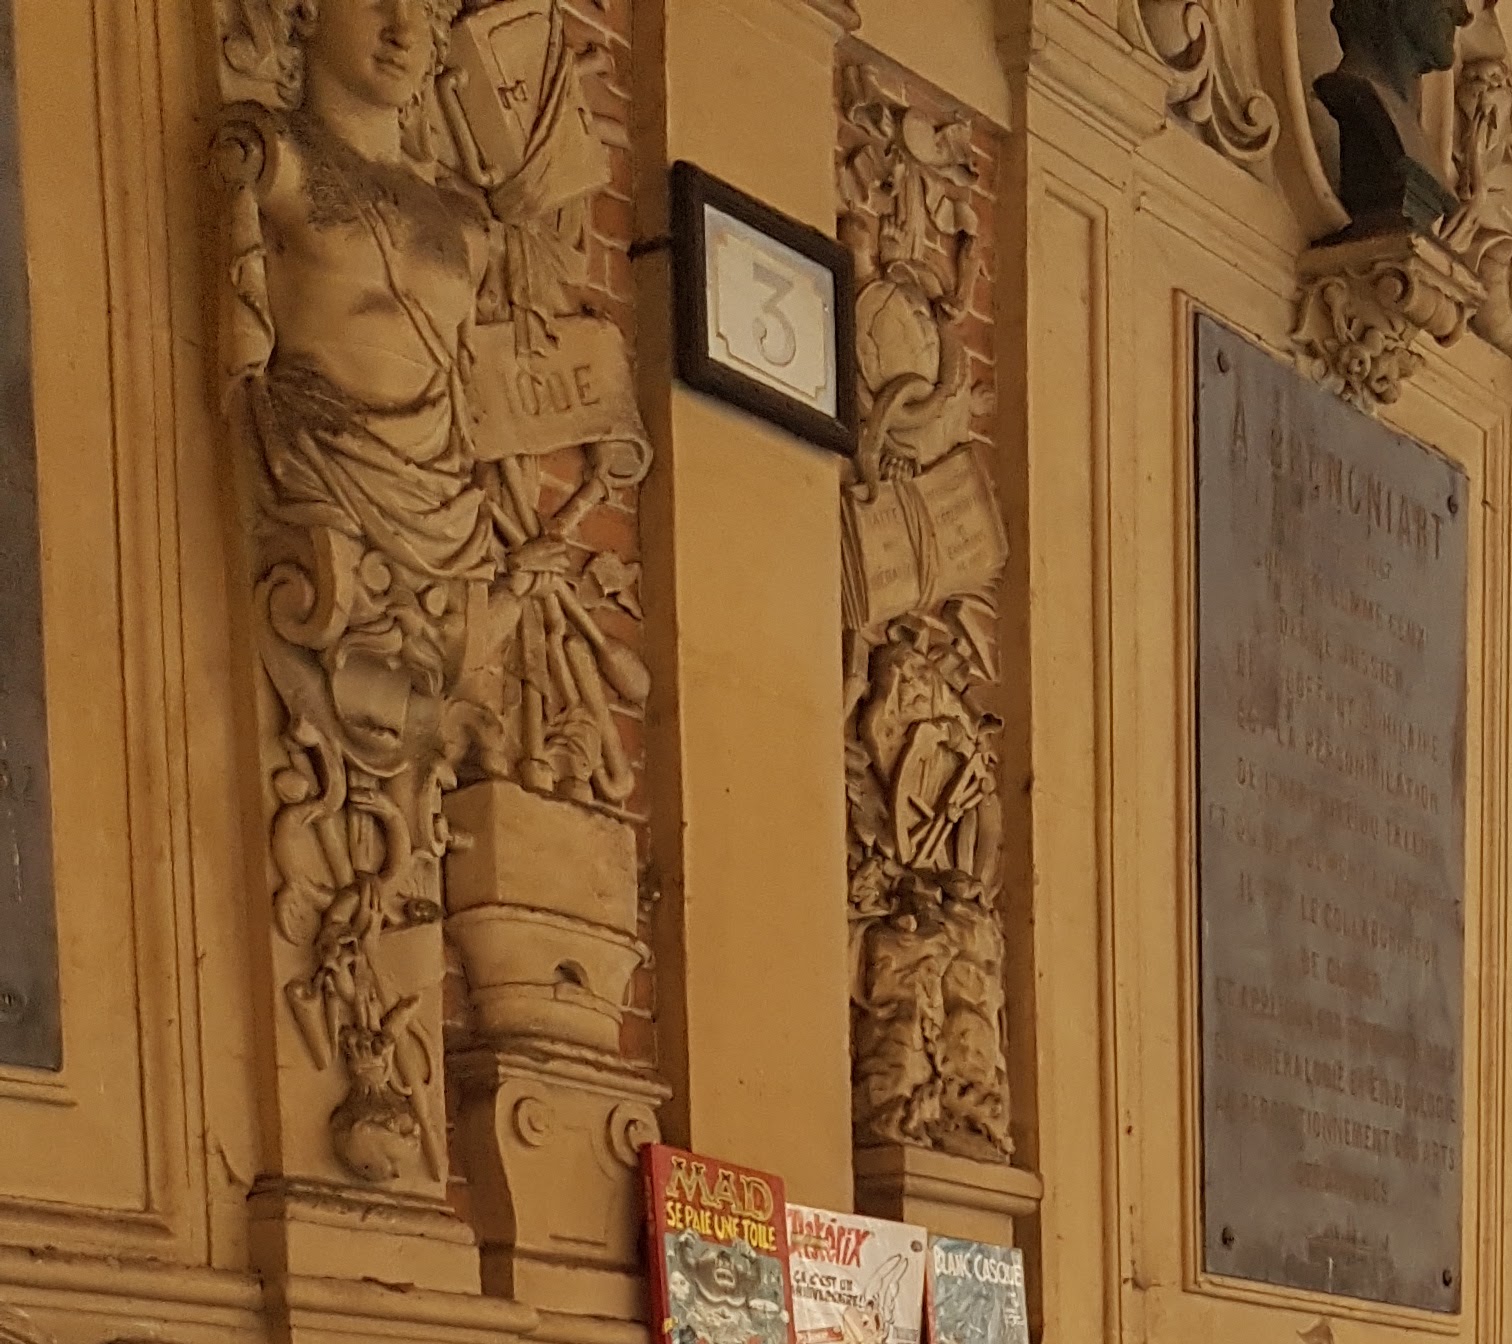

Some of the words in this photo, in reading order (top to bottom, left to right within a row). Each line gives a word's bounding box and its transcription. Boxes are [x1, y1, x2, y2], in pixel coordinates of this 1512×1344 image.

[752, 262, 796, 367] 3
[666, 1156, 774, 1222] MAD
[666, 1201, 684, 1230] SE
[685, 1205, 712, 1236] PAIE
[714, 1214, 740, 1240] UNE
[741, 1219, 777, 1251] TOILE
